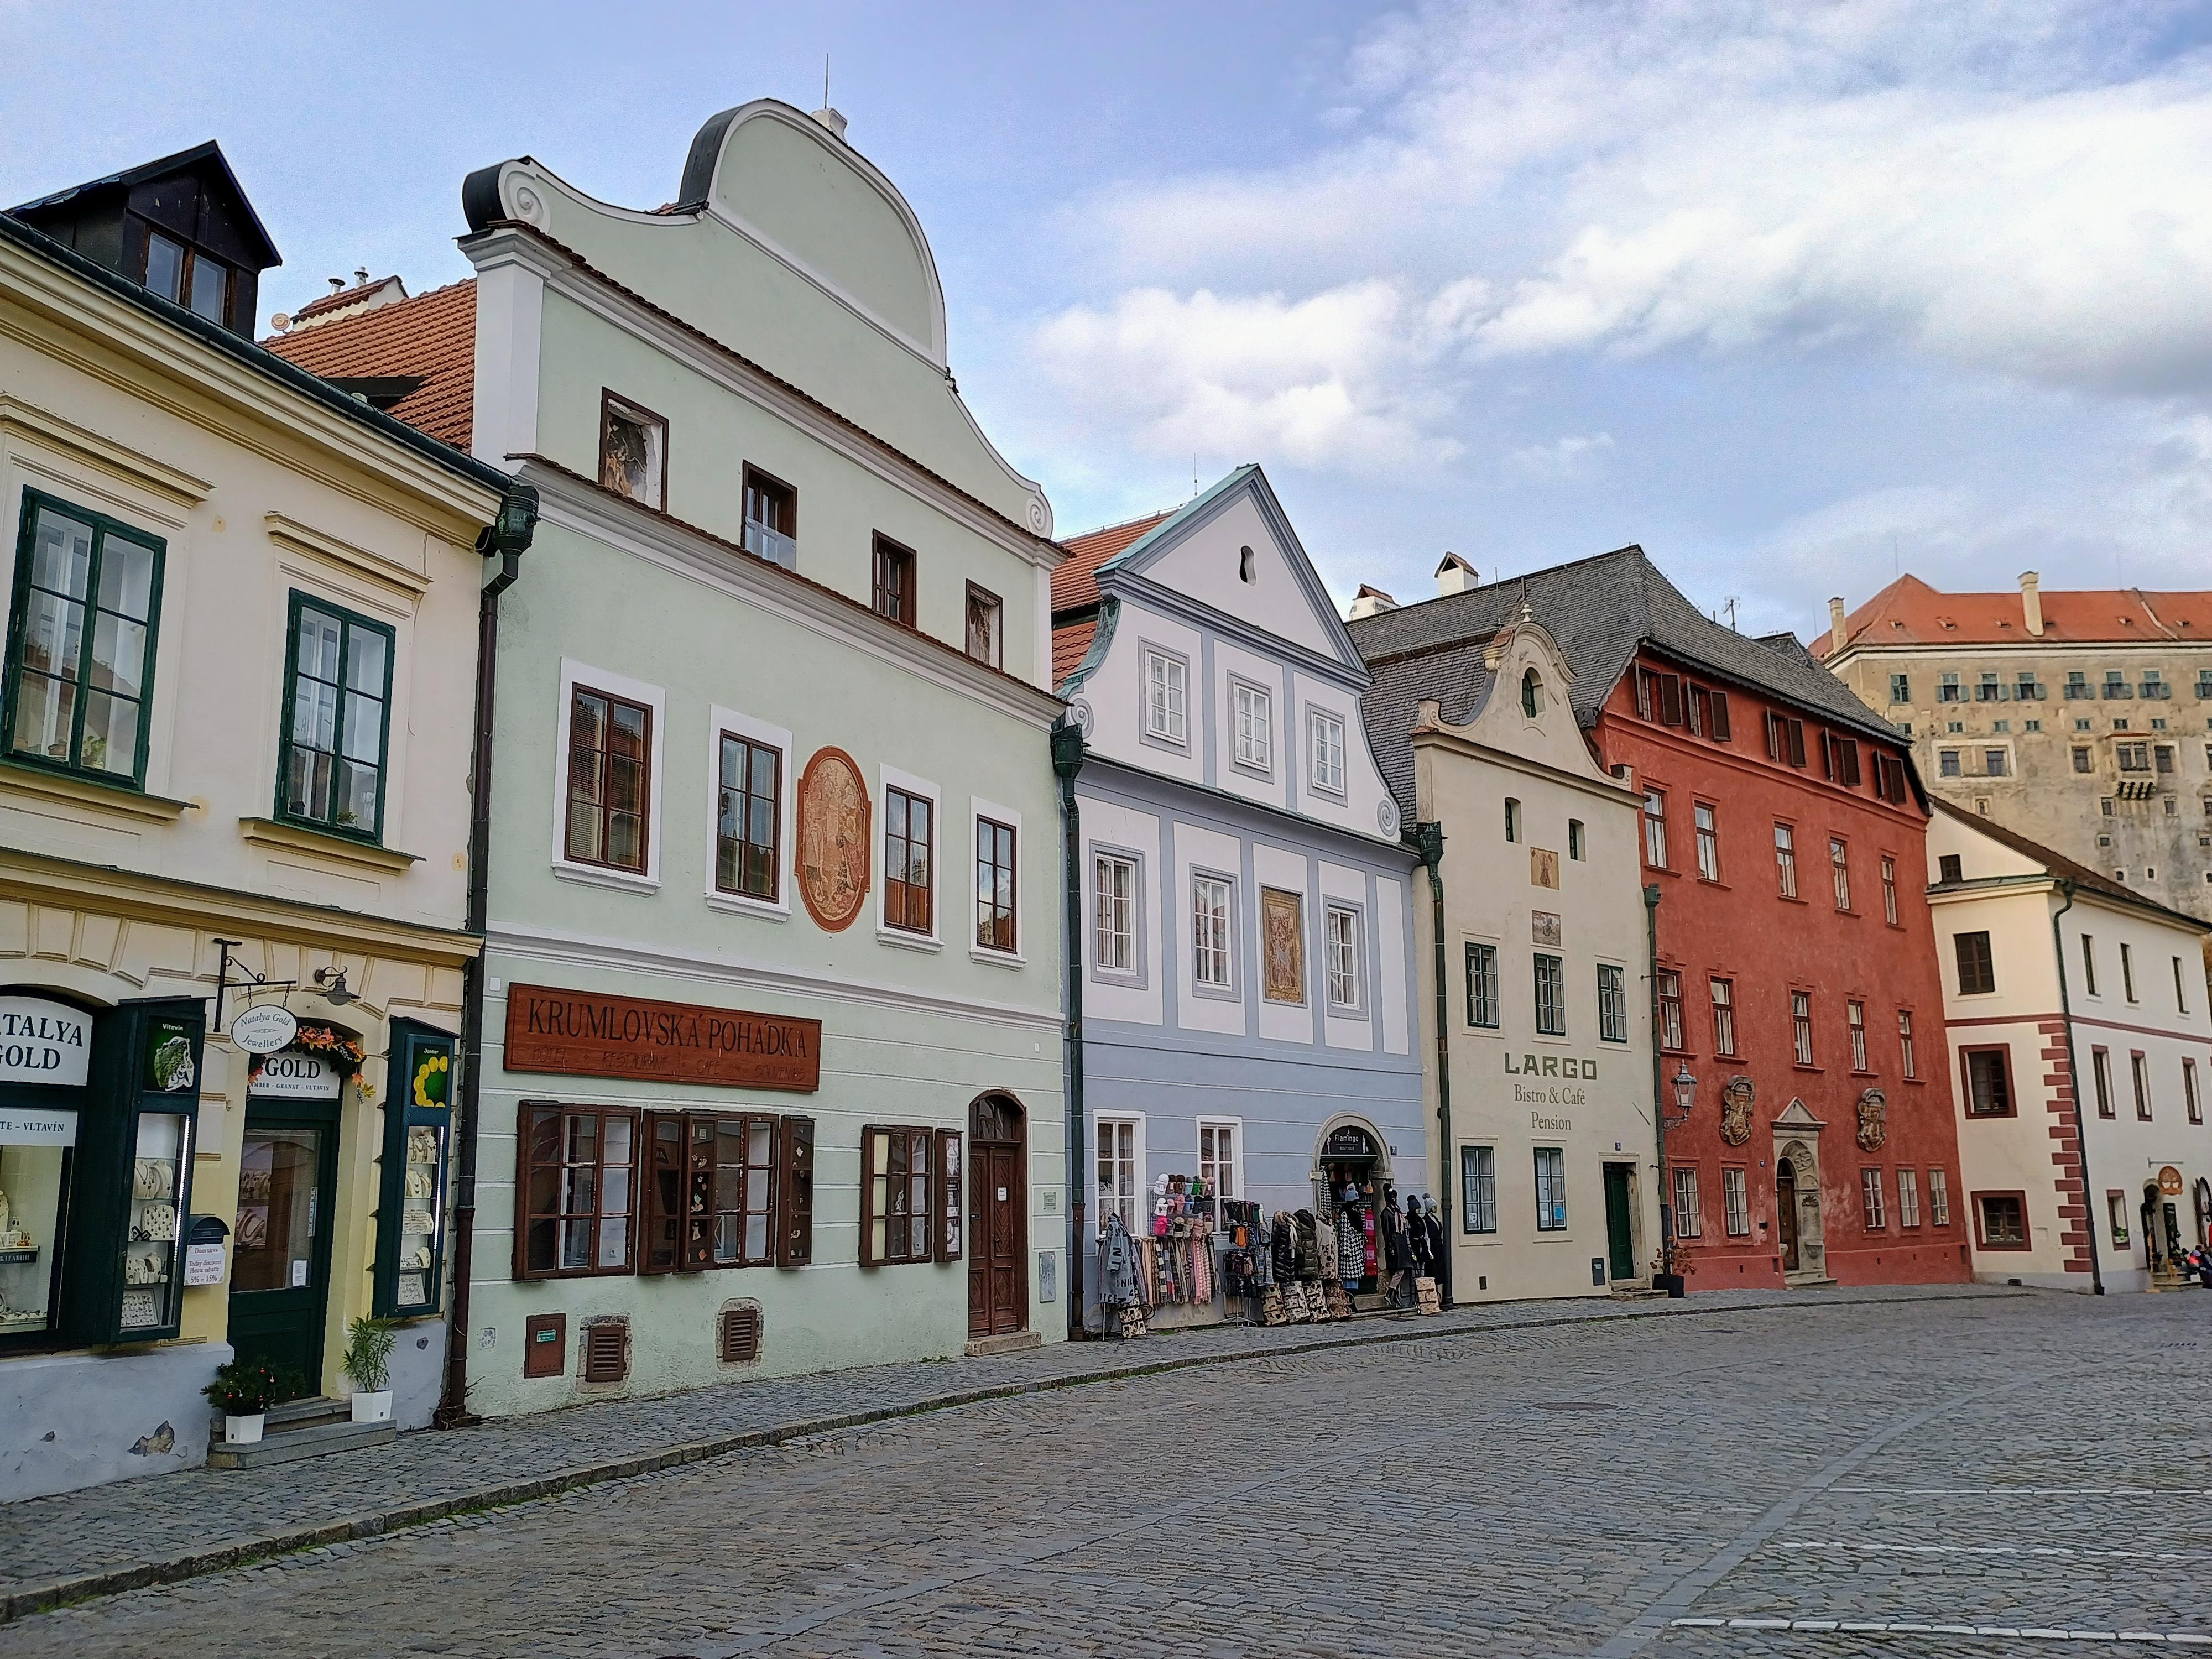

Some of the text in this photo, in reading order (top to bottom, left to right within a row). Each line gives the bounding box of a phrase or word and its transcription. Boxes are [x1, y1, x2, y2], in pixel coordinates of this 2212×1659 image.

[240, 1013, 291, 1027] Natalya Gold
[527, 998, 808, 1058] KRUMLOVSKÁ POHÁDKA
[0, 1014, 82, 1047] TALYA
[242, 1035, 283, 1048] Jewellery
[0, 1045, 60, 1070] OLD
[1505, 1052, 1597, 1080] LARGO
[265, 1057, 321, 1078] GOLD
[1514, 1084, 1585, 1105] Bistro & Café
[23, 1121, 65, 1131] VLTAVÍN
[1531, 1112, 1572, 1130] Pension
[1334, 1134, 1359, 1143] Flamingo
[205, 1274, 217, 1282] 15%
